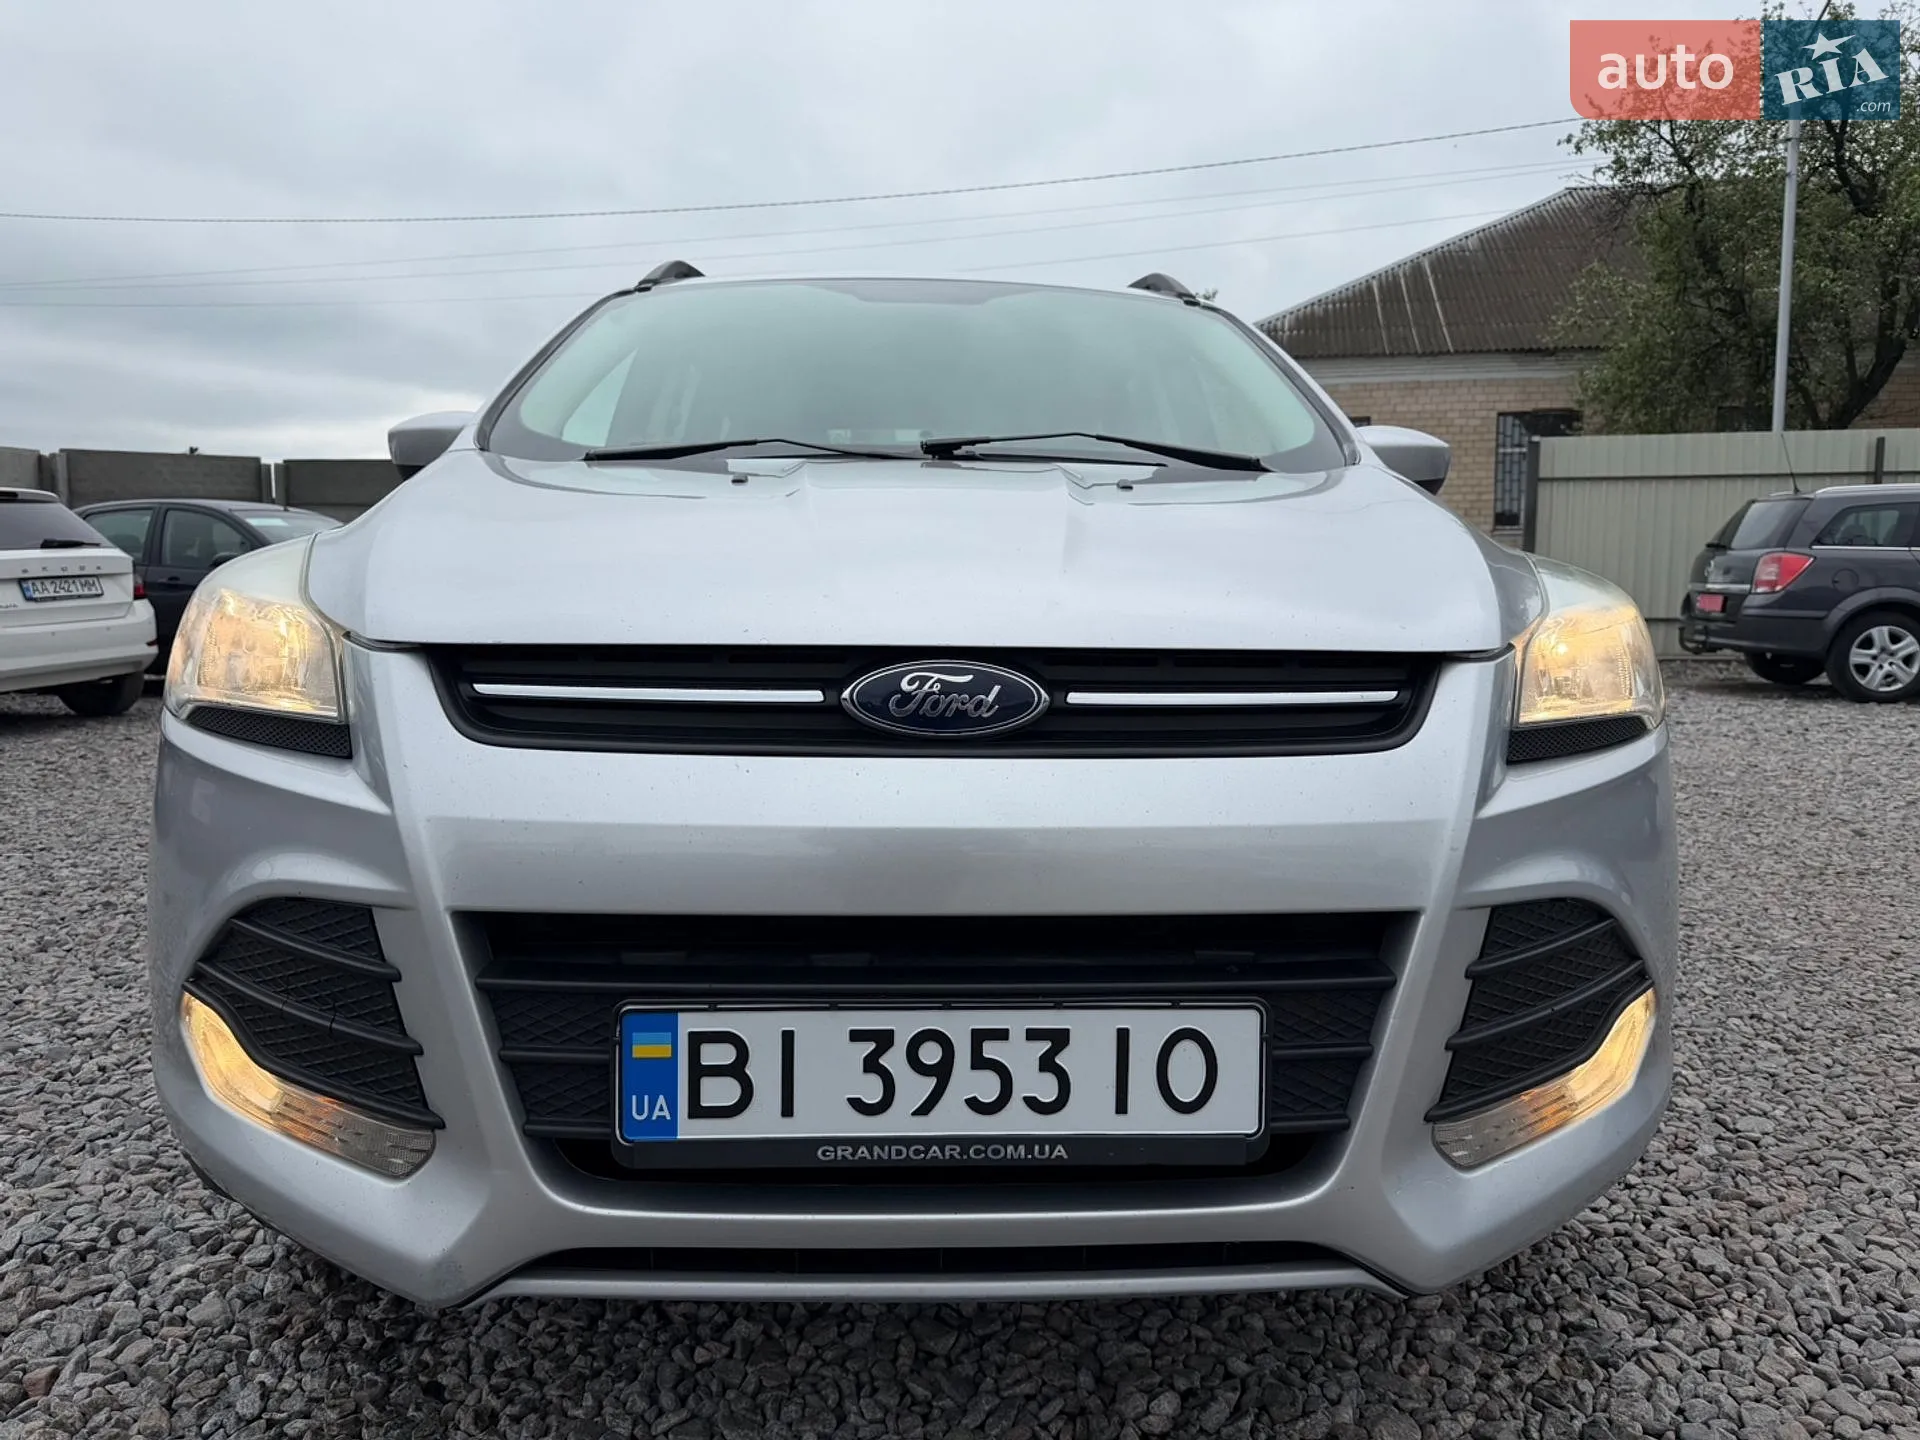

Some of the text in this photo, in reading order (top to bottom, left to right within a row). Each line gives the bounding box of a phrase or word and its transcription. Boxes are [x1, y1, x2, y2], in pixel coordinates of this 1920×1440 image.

[30, 582, 50, 595] AA
[888, 671, 1002, 718] Ford
[687, 1026, 1219, 1120] BI 3953 IO
[631, 1094, 671, 1121] UA
[816, 1144, 1069, 1161] GRANDCAR.COM.UA
